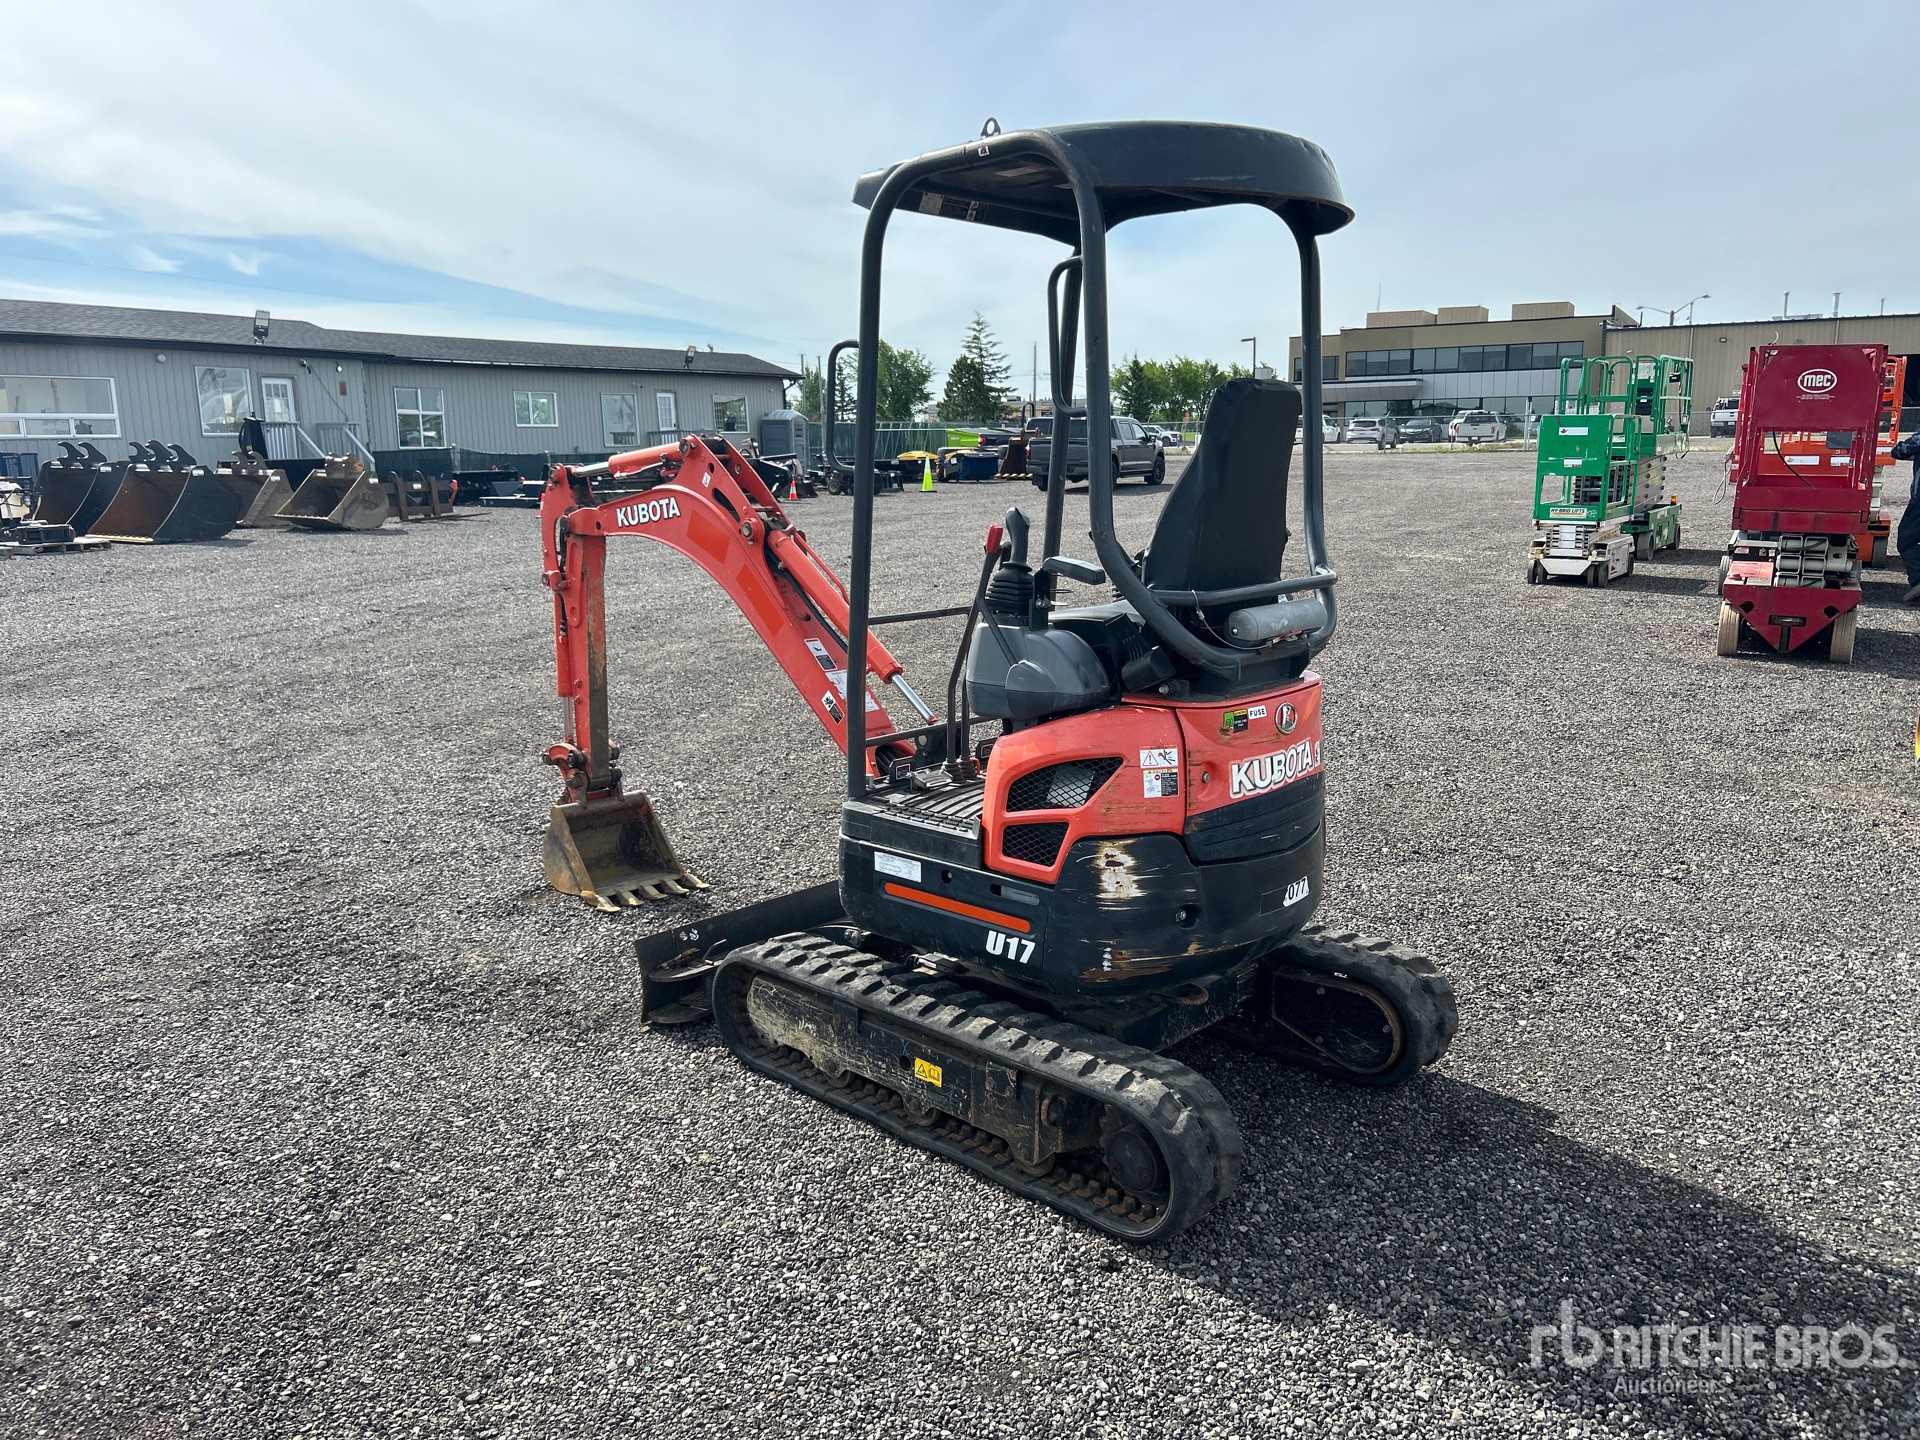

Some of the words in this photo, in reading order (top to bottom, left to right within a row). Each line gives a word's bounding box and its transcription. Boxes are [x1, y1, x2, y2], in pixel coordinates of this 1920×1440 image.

[616, 497, 681, 528] KUBOTA
[1249, 708, 1266, 718] FUSE
[1231, 739, 1313, 796] KUBOTA
[1288, 877, 1306, 901] 077
[985, 930, 1036, 964] U17
